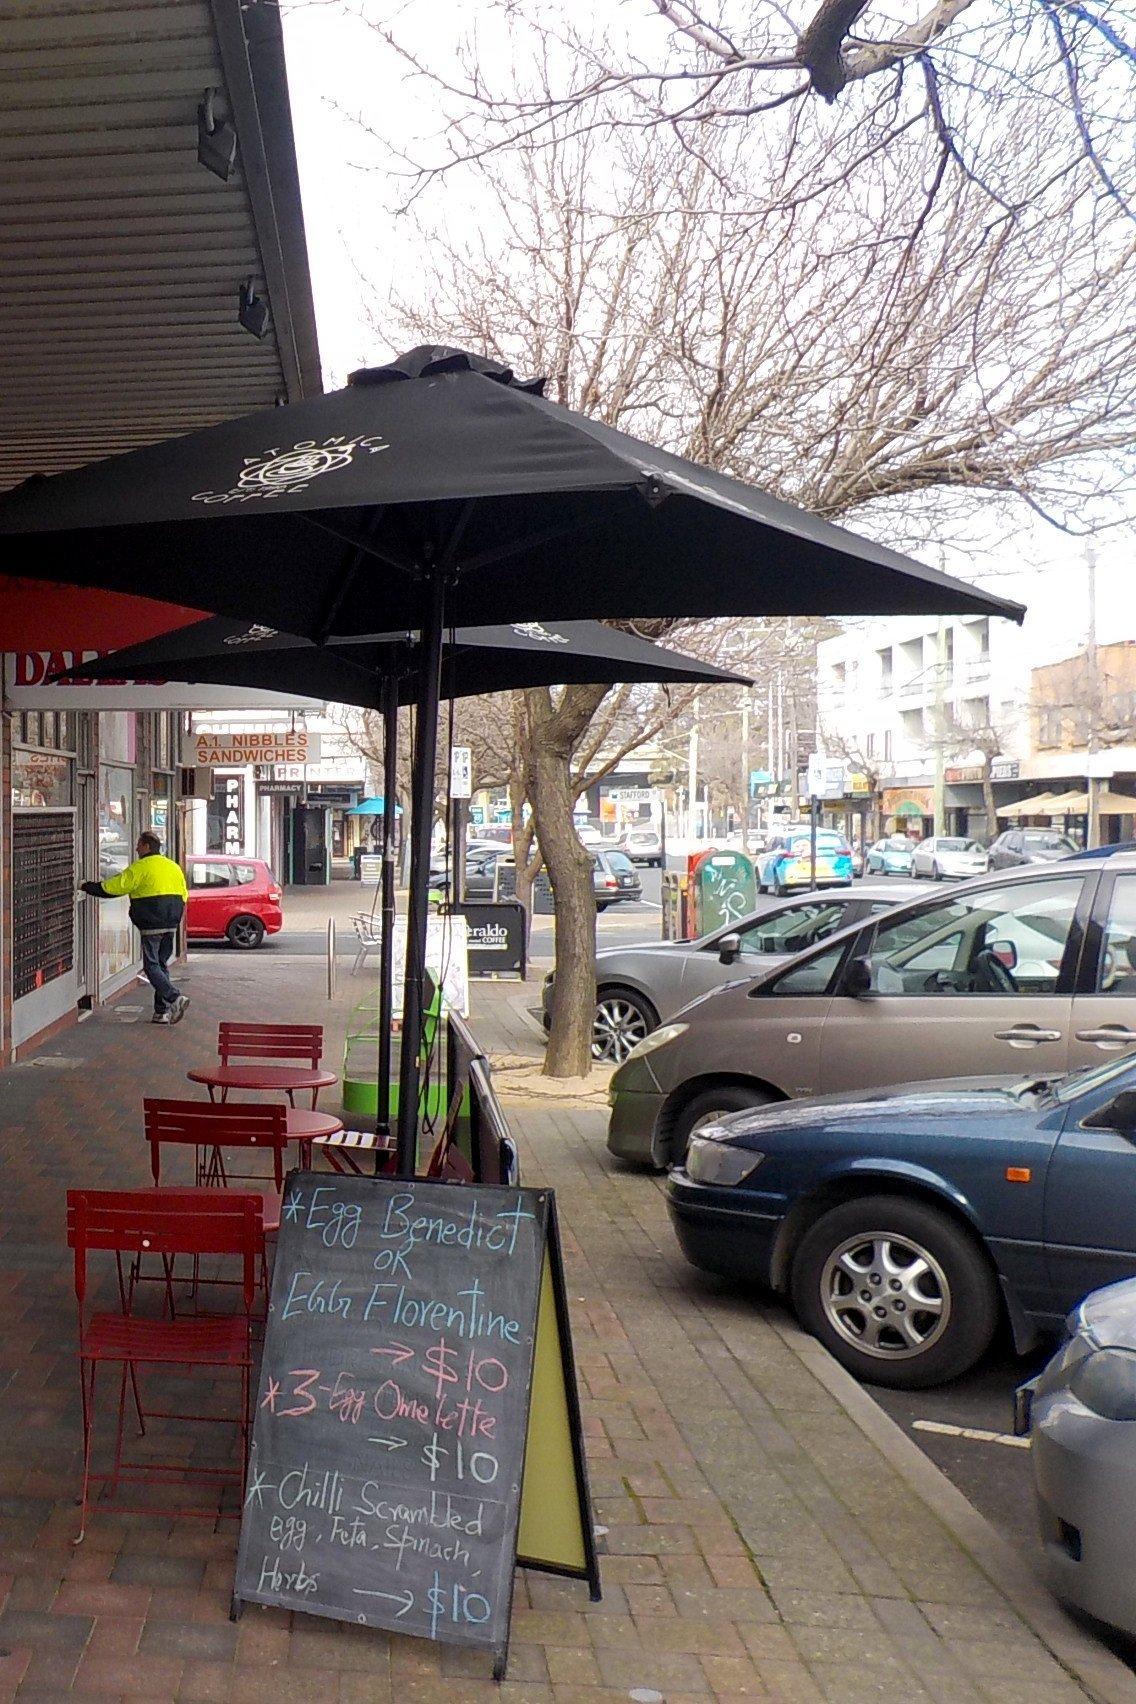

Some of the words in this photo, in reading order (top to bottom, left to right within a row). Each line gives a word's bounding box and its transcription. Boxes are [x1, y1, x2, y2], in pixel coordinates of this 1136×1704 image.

[244, 435, 390, 465] ATOMICA
[191, 484, 309, 503] COFFEE
[197, 749, 308, 764] SANDWICHES
[232, 733, 308, 747] NIBBLES
[259, 785, 302, 793] PHARMACY
[620, 789, 650, 800] STAFFORD
[466, 923, 508, 937] eraldo
[482, 936, 506, 944] COFFEE
[307, 1187, 361, 1248] Egg
[380, 1192, 535, 1256] Benedict
[363, 1279, 522, 1345] Florentine
[423, 1338, 509, 1398] $10
[374, 1378, 497, 1440] Omelette
[421, 1433, 499, 1483] $10
[279, 1469, 344, 1515] Chilli
[359, 1482, 484, 1537] Scrambled
[258, 1557, 320, 1593] Herbs
[422, 1570, 491, 1640] $10
